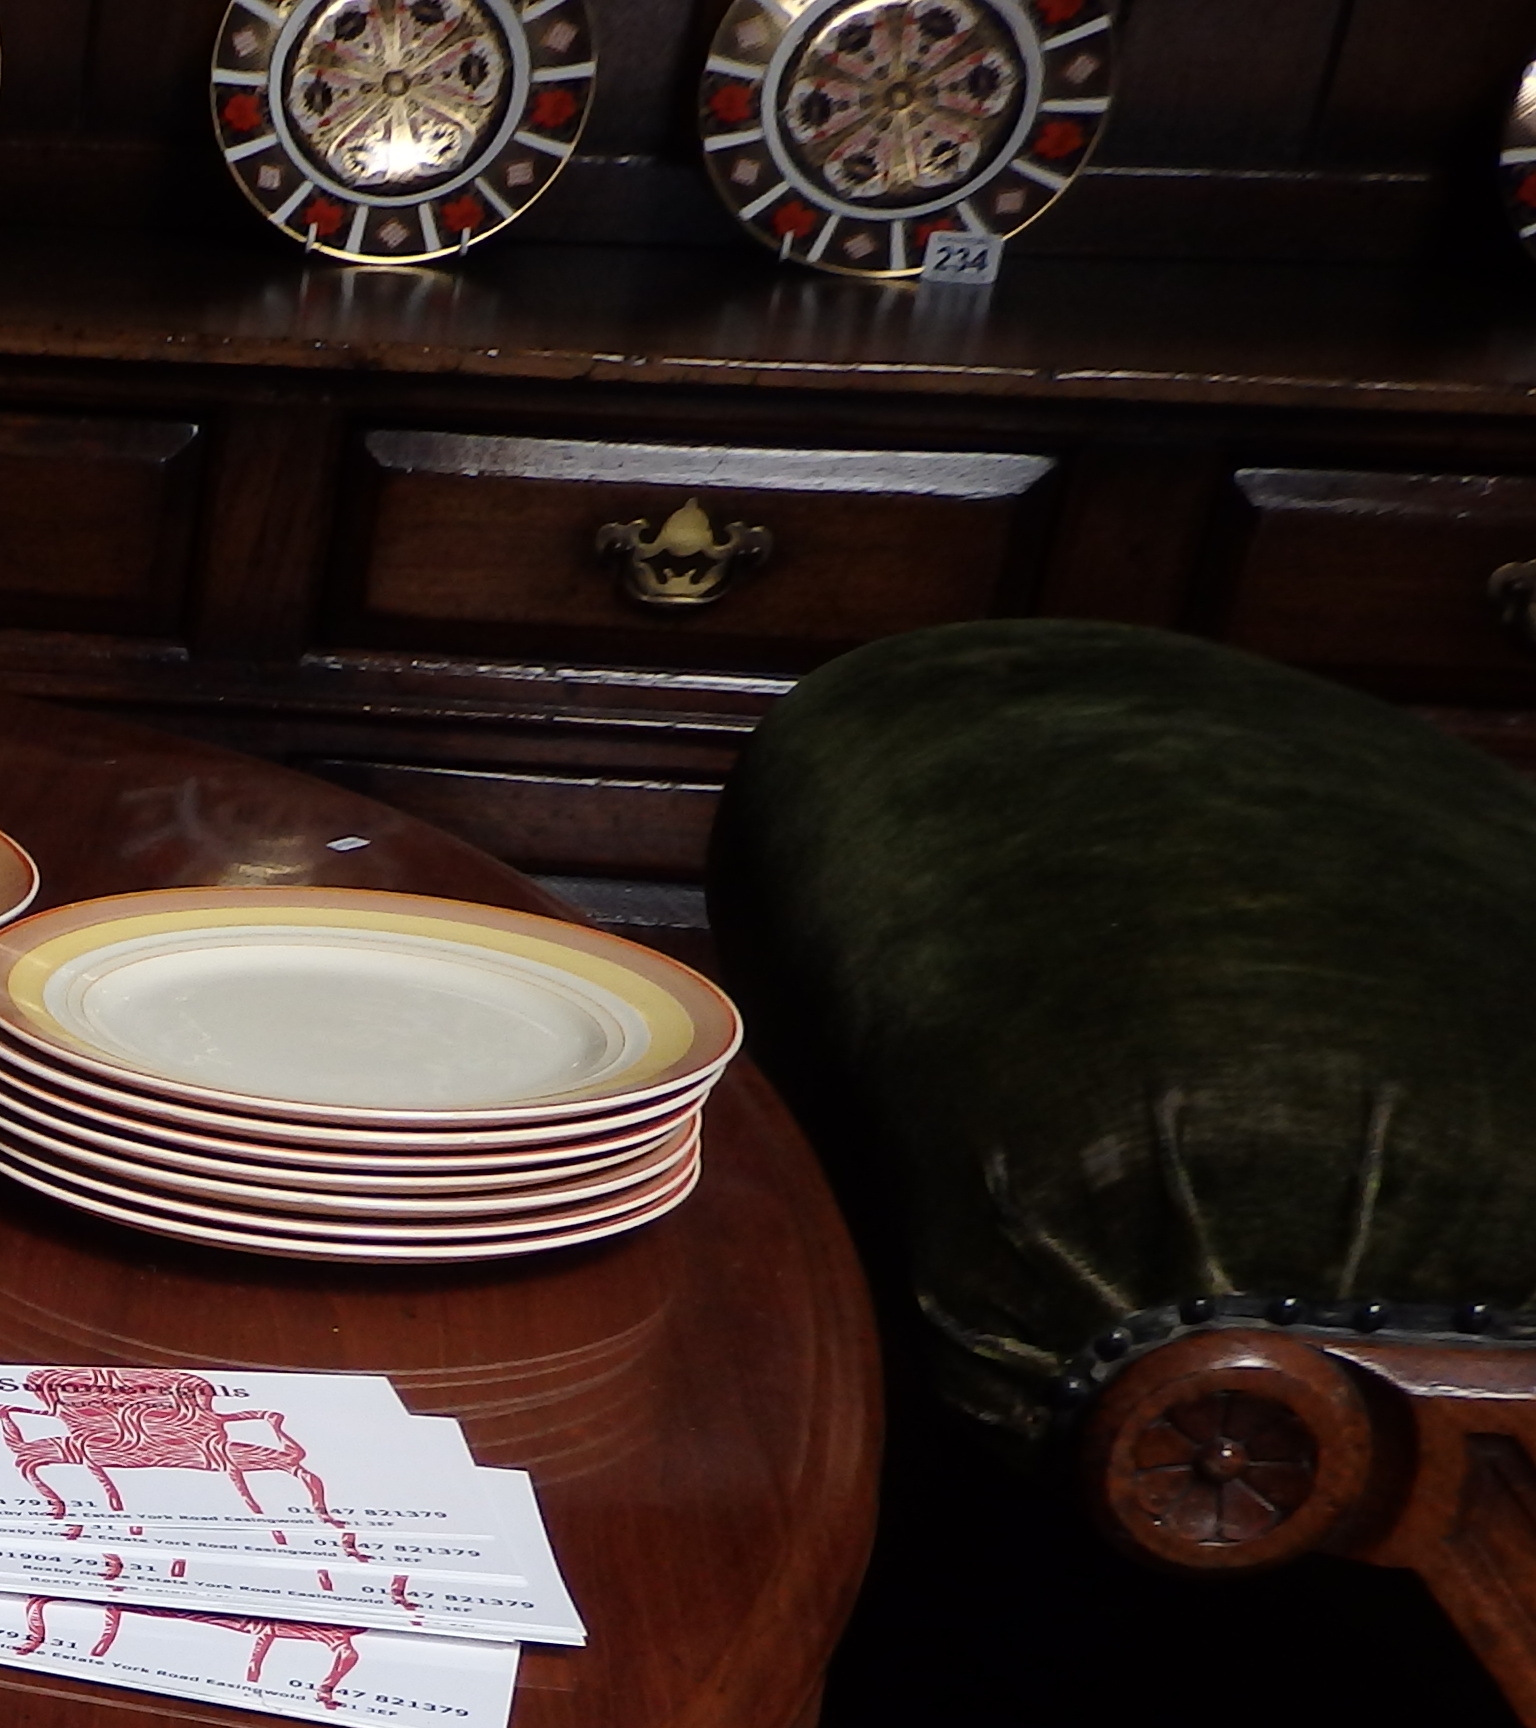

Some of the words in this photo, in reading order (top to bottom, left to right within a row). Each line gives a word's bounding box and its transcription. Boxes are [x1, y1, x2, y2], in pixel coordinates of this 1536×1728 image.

[933, 245, 988, 272] 234
[224, 1516, 314, 1524] Easingwold
[364, 1508, 448, 1519] 821379
[98, 1534, 148, 1544] Estate
[154, 1538, 191, 1547] York
[197, 1542, 238, 1550] Road
[244, 1545, 338, 1558] Easingwold
[394, 1544, 481, 1557] 821379
[23, 1564, 73, 1575] Roxby
[136, 1575, 188, 1586] Estate
[194, 1580, 233, 1590] York
[239, 1585, 281, 1595] Road
[287, 1589, 384, 1604] Easingwold
[445, 1594, 535, 1609] 821379
[52, 1651, 105, 1667] Estate
[112, 1662, 150, 1674] York
[157, 1670, 199, 1682] Road
[206, 1678, 306, 1701] Easingwold
[366, 1706, 398, 1716] 3EF
[375, 1694, 469, 1717] 821379
